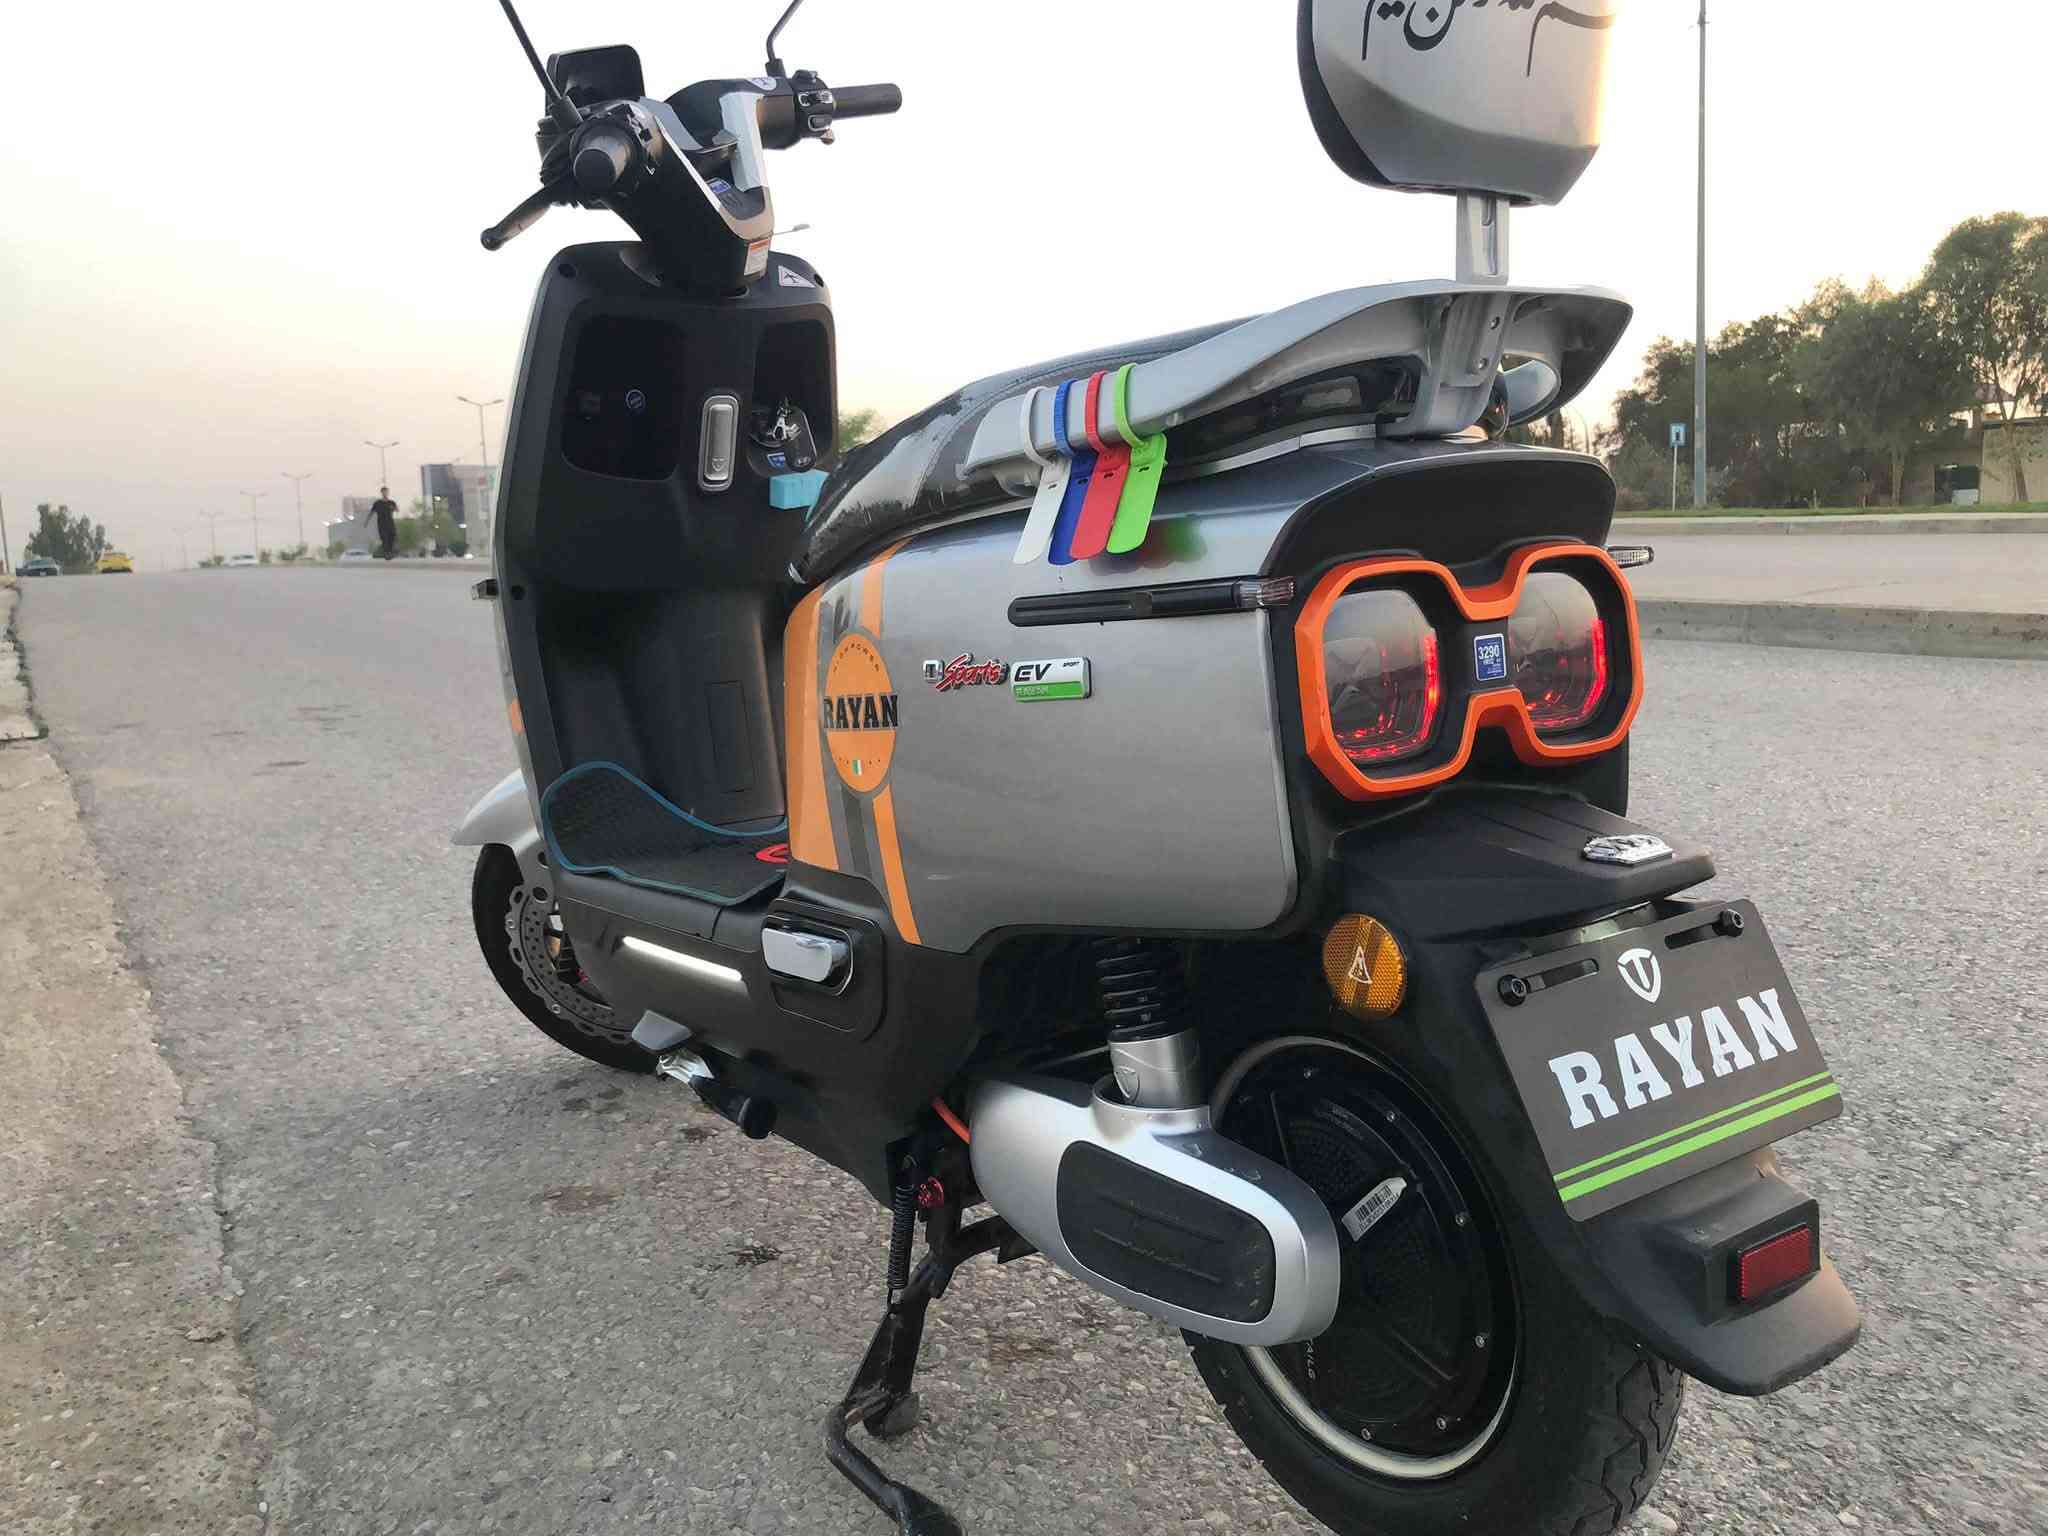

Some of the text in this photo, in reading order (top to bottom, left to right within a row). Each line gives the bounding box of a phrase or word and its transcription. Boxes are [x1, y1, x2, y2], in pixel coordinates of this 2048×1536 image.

[1477, 645, 1500, 660] 3290
[1014, 662, 1053, 682] EV
[823, 694, 899, 729] RAYAN
[1547, 987, 1799, 1130] RAYAN
